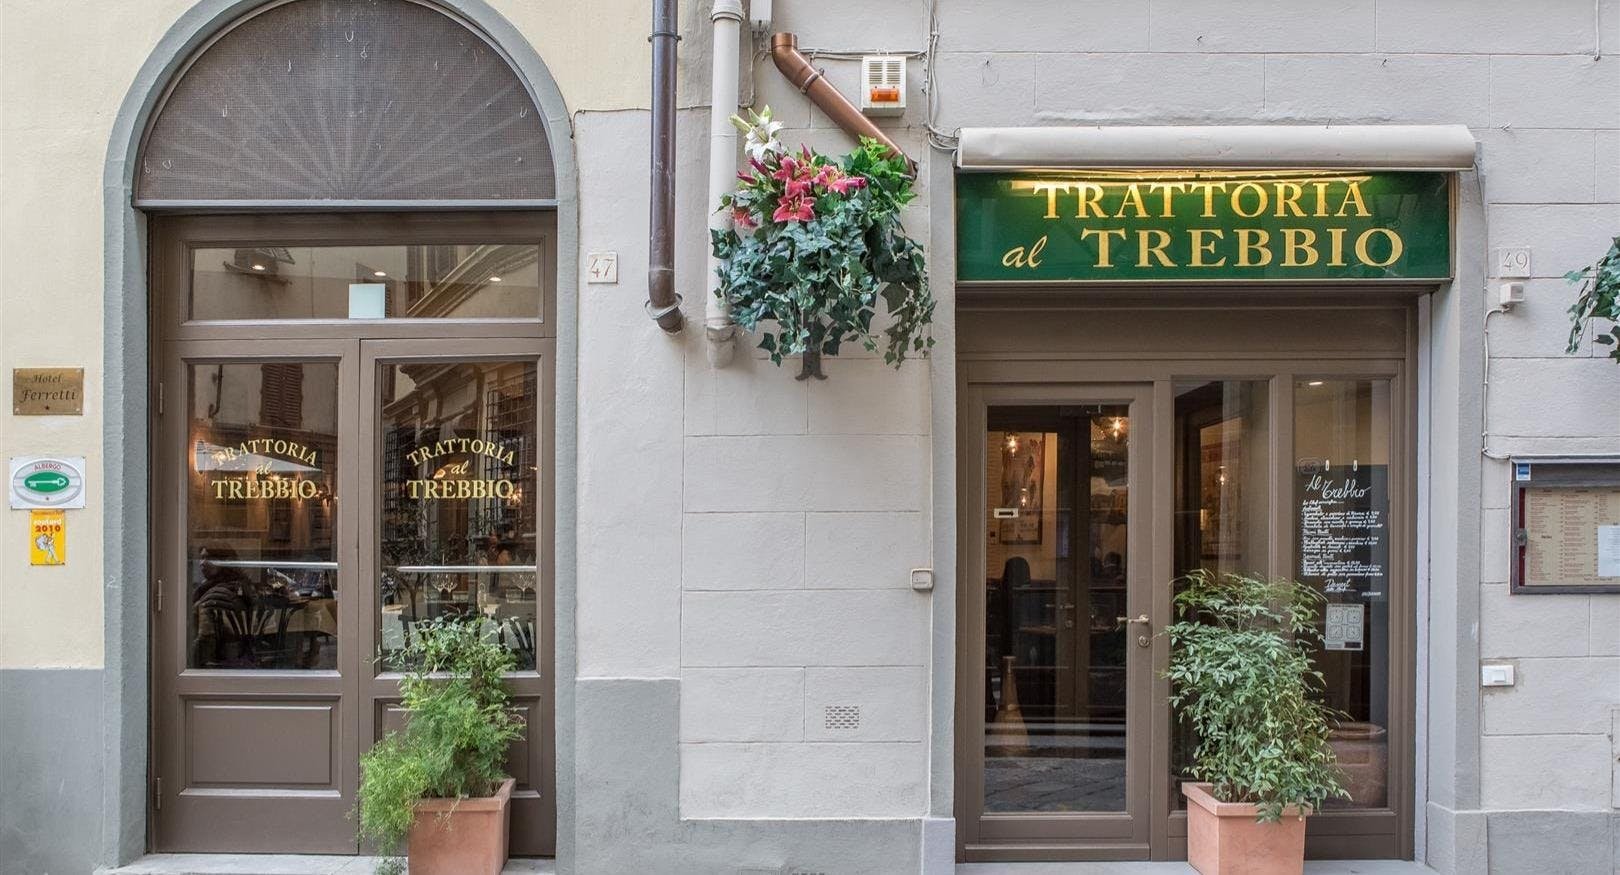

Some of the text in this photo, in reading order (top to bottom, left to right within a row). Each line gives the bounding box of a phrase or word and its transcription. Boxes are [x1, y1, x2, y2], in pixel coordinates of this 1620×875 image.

[1033, 181, 1372, 219] TRATTORIA
[1002, 227, 1404, 269] al TREBBIO
[590, 257, 615, 279] 47
[1504, 252, 1528, 271] 49
[32, 374, 63, 384] Hotel
[20, 389, 77, 404] Ferretti
[211, 438, 318, 466] TRATTORIA
[406, 438, 515, 466] TRATTORIA
[33, 463, 62, 472] ALBERGO
[256, 460, 273, 475] al
[451, 460, 470, 475] al
[211, 479, 317, 499] TREBBIO
[406, 479, 514, 499] TREBBIO
[35, 525, 61, 533] 2010
